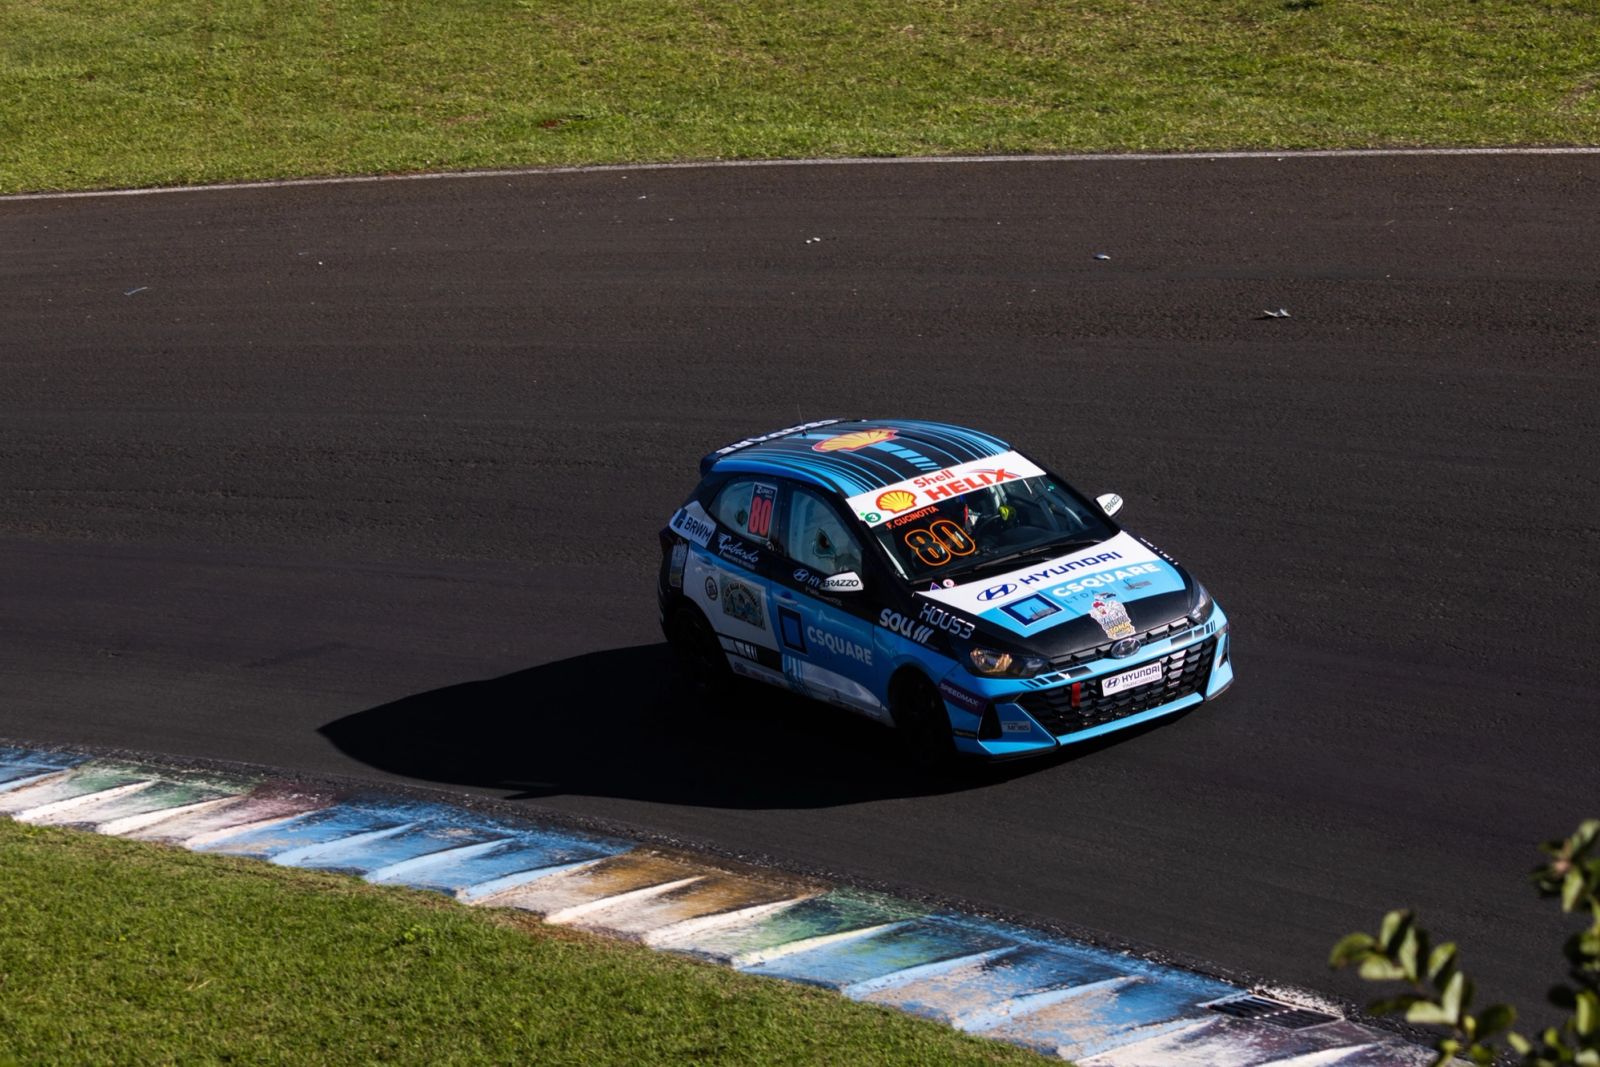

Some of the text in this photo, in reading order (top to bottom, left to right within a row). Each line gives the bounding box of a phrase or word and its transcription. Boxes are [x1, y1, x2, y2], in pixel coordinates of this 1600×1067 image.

[913, 469, 955, 488] Shell
[923, 468, 1016, 501] HELIX
[684, 516, 712, 540] BRWM
[749, 496, 772, 537] 80
[904, 520, 976, 566] 80
[823, 578, 859, 587] BRAZZO
[1019, 551, 1123, 585] HYUNDAI
[1051, 563, 1161, 597] CSQUARE
[919, 602, 976, 640] HOUS3
[807, 626, 873, 666] CSQUARE
[1121, 665, 1160, 683] HYUNDAI
